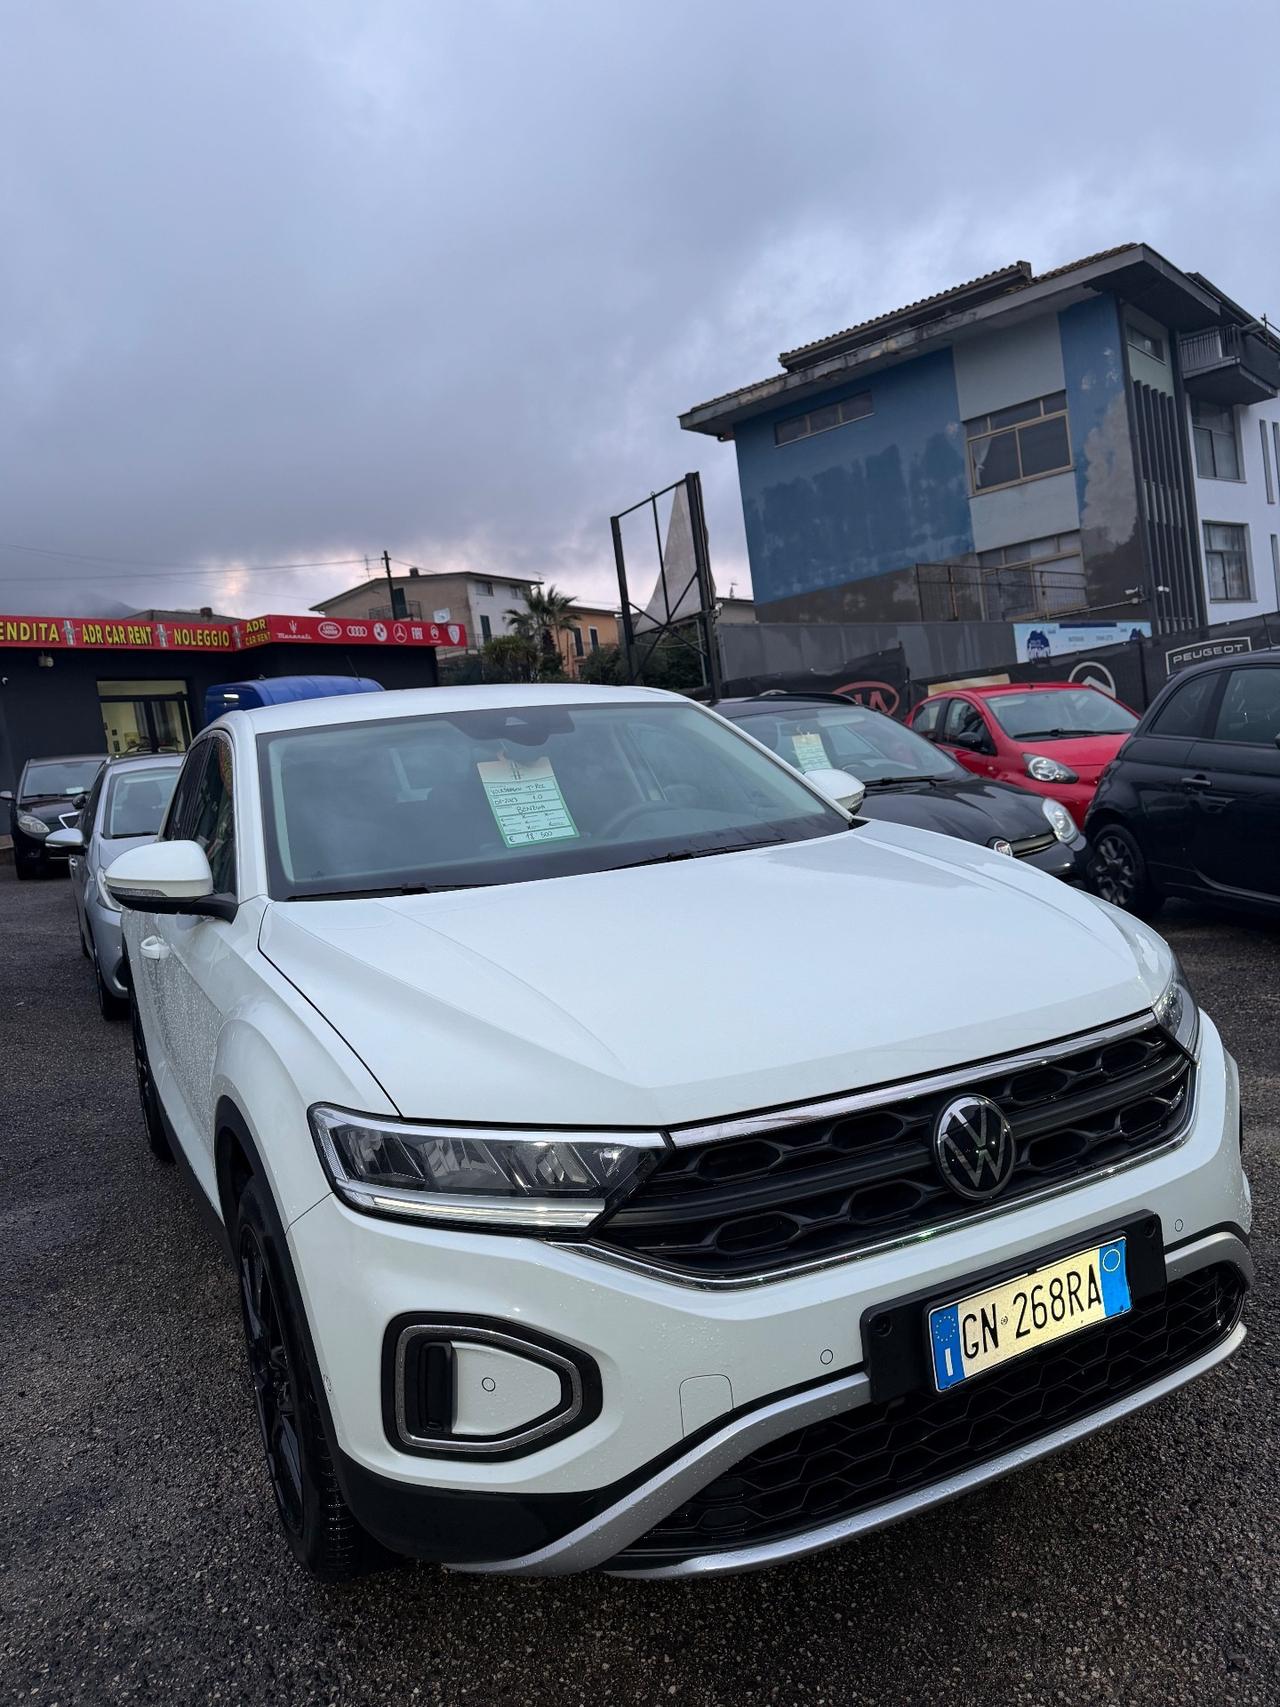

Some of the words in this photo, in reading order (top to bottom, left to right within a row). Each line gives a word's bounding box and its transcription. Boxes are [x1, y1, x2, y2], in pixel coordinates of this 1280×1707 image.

[82, 623, 104, 644] ADR
[105, 624, 127, 645] CAR
[128, 625, 153, 646] RENT
[173, 627, 230, 647] NOLEGGIO
[246, 618, 267, 634] ADR
[1172, 643, 1244, 665] PEUGEOT
[961, 1302, 999, 1360] GN
[1012, 1263, 1102, 1340] 268RA
